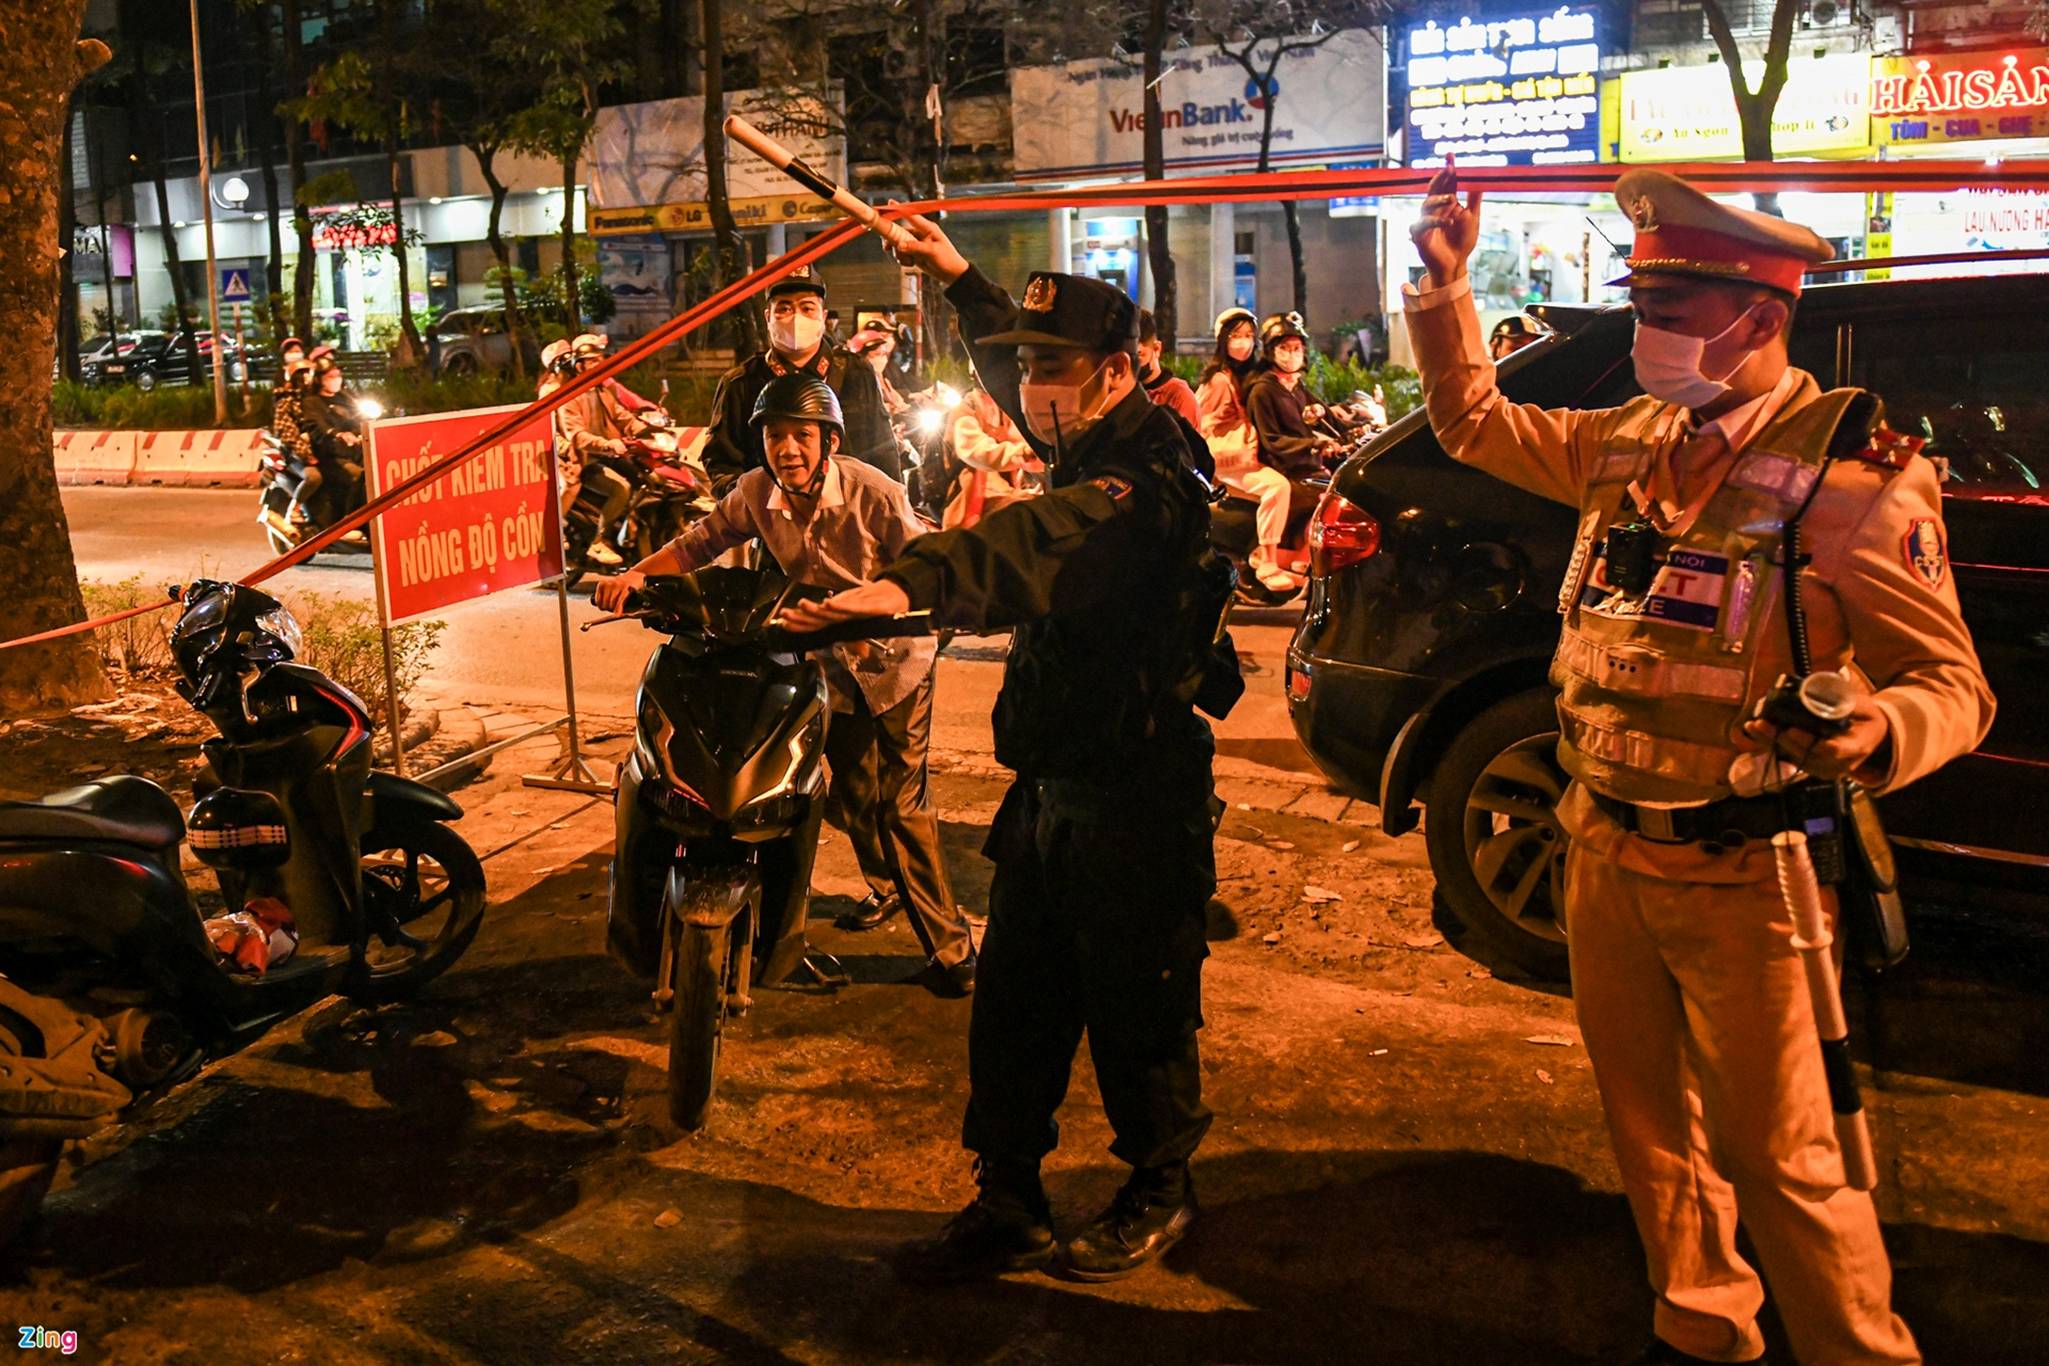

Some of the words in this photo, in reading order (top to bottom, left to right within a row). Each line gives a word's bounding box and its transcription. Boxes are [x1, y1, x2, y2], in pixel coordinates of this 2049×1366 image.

[686, 209, 702, 223] LG
[510, 440, 549, 487] TRA
[398, 520, 465, 588] NỒNG
[468, 513, 498, 574] ĐỘ
[503, 501, 546, 561] CỒN
